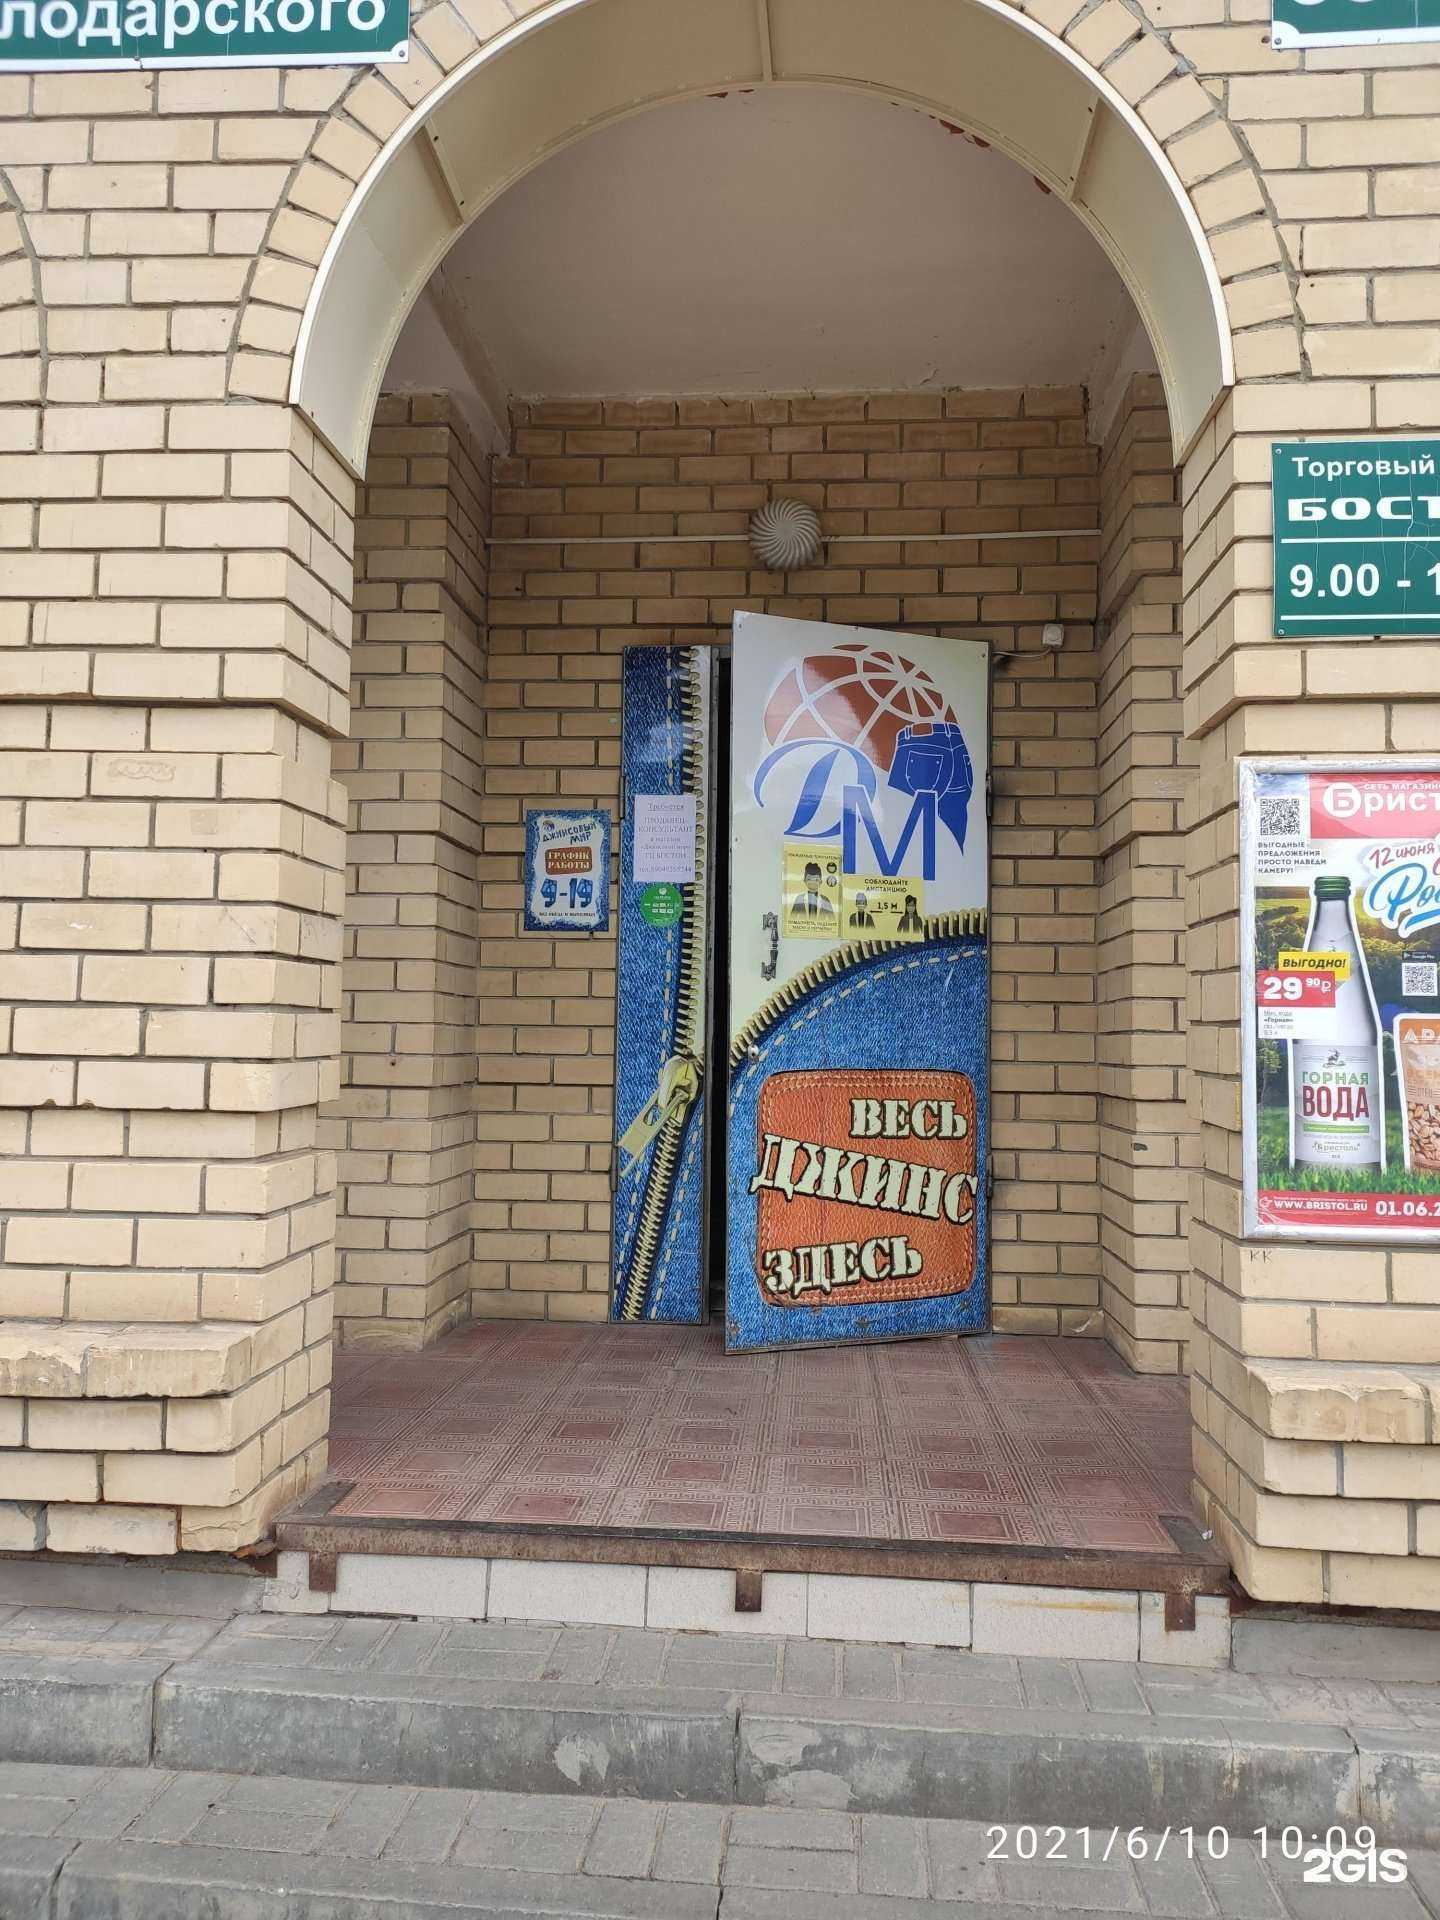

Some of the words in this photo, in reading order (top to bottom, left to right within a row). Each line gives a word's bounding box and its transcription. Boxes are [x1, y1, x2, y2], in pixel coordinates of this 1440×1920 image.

[1291, 454, 1435, 482] Торговый
[1289, 563, 1380, 598] 9.00
[1396, 579, 1412, 588] -
[548, 851, 590, 861] ГРАФИК
[548, 861, 590, 870] РАБОТЫ
[1369, 847, 1395, 869] 12
[1395, 842, 1435, 858] июня
[864, 878, 908, 886] СОБЛЮДАЙТЕ
[877, 902, 889, 911] 1,5
[1282, 959, 1346, 969] ВЫГОДНО!
[1263, 976, 1303, 1001] 29
[1302, 1071, 1369, 1085] ГОРНАЯ
[1302, 1085, 1370, 1121] ВОДА
[849, 1097, 969, 1141] ВЕСЬ
[749, 1131, 979, 1226] ДЖИНС
[1273, 1200, 1368, 1212] WWW.BRISTOL.RU
[762, 1235, 925, 1299] ЗДЕСЬ
